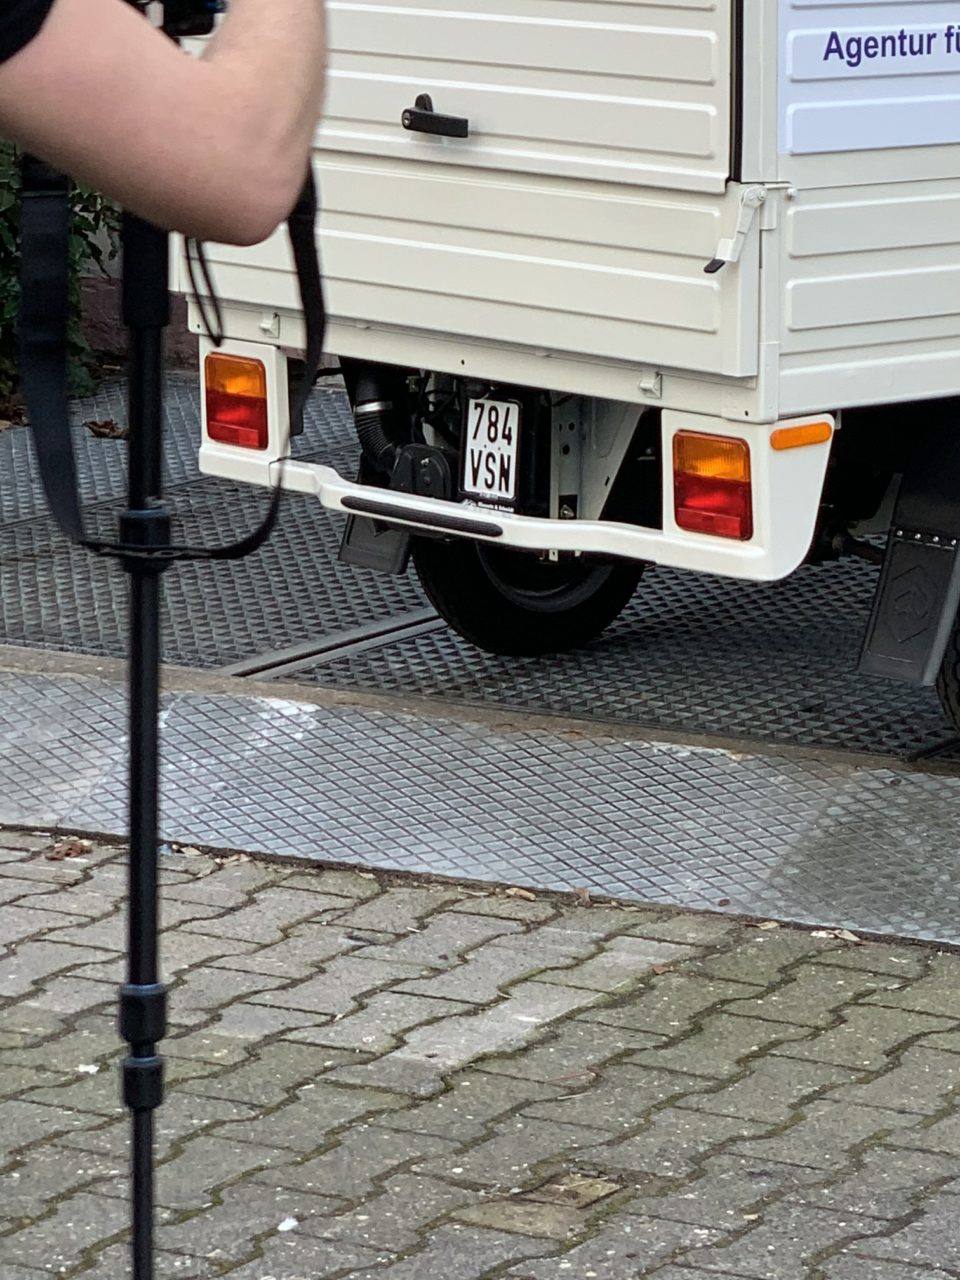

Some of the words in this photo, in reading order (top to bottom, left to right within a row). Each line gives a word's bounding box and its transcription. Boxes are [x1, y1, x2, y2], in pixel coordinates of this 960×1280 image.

[822, 28, 937, 68] Agentur
[472, 402, 513, 446] 784
[470, 448, 511, 493] VSN
